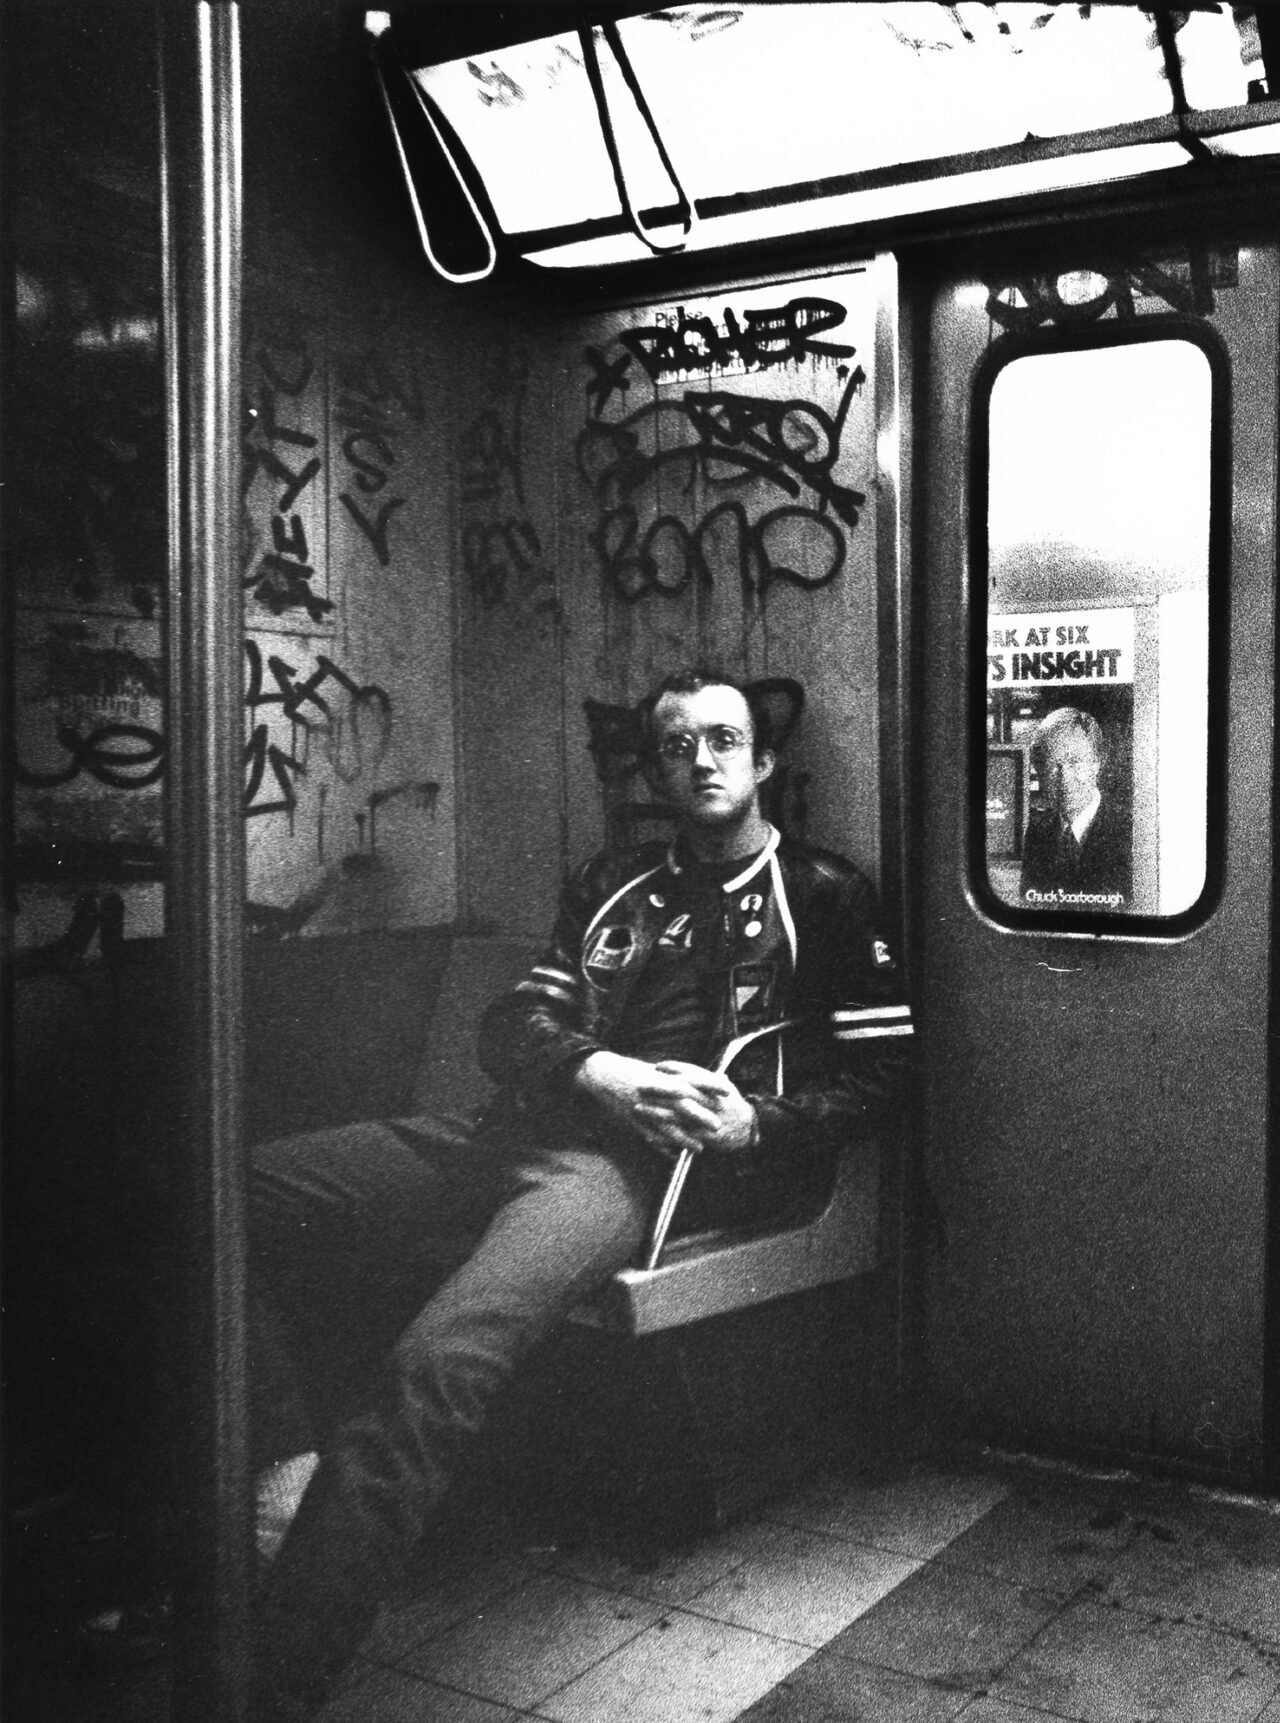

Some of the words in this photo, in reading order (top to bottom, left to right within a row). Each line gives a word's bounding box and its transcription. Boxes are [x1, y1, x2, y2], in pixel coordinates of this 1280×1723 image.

[655, 311, 703, 327] Plese
[1025, 627, 1051, 647] AT
[1056, 625, 1090, 646] SIX
[1012, 649, 1122, 680] INSIGHT
[1026, 889, 1057, 903] Chuck
